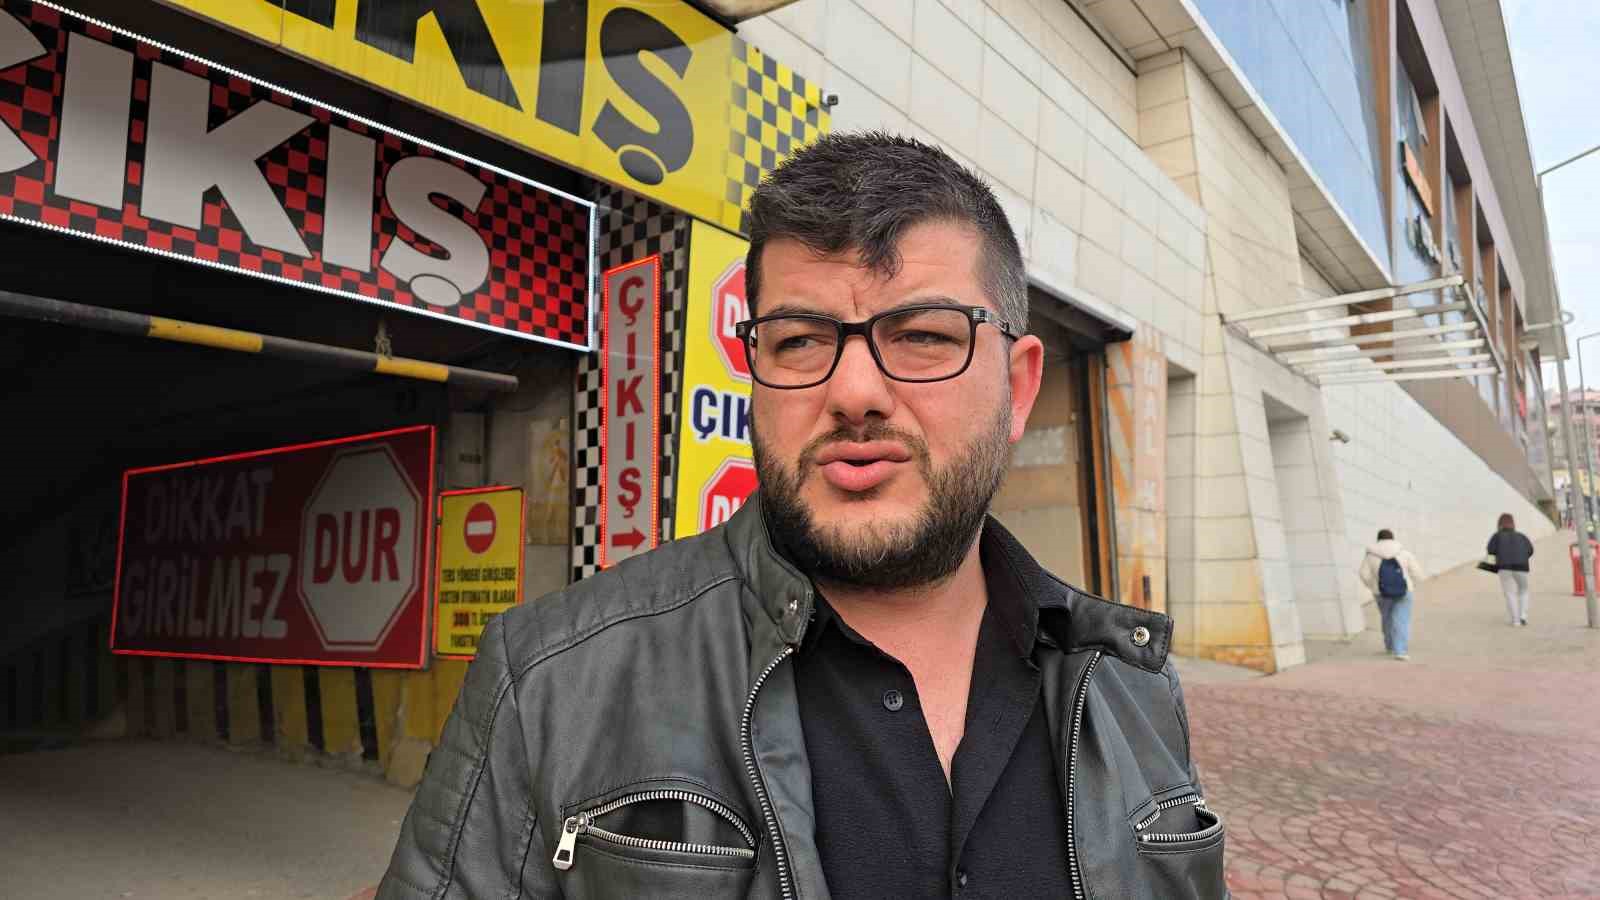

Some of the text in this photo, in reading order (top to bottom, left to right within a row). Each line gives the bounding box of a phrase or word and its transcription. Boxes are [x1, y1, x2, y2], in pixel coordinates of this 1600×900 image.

[617, 277, 644, 517] ÇIKIŞ
[146, 469, 272, 542] DİKKAT
[313, 509, 401, 583] DUR
[125, 554, 291, 639] GİRİLMEZ
